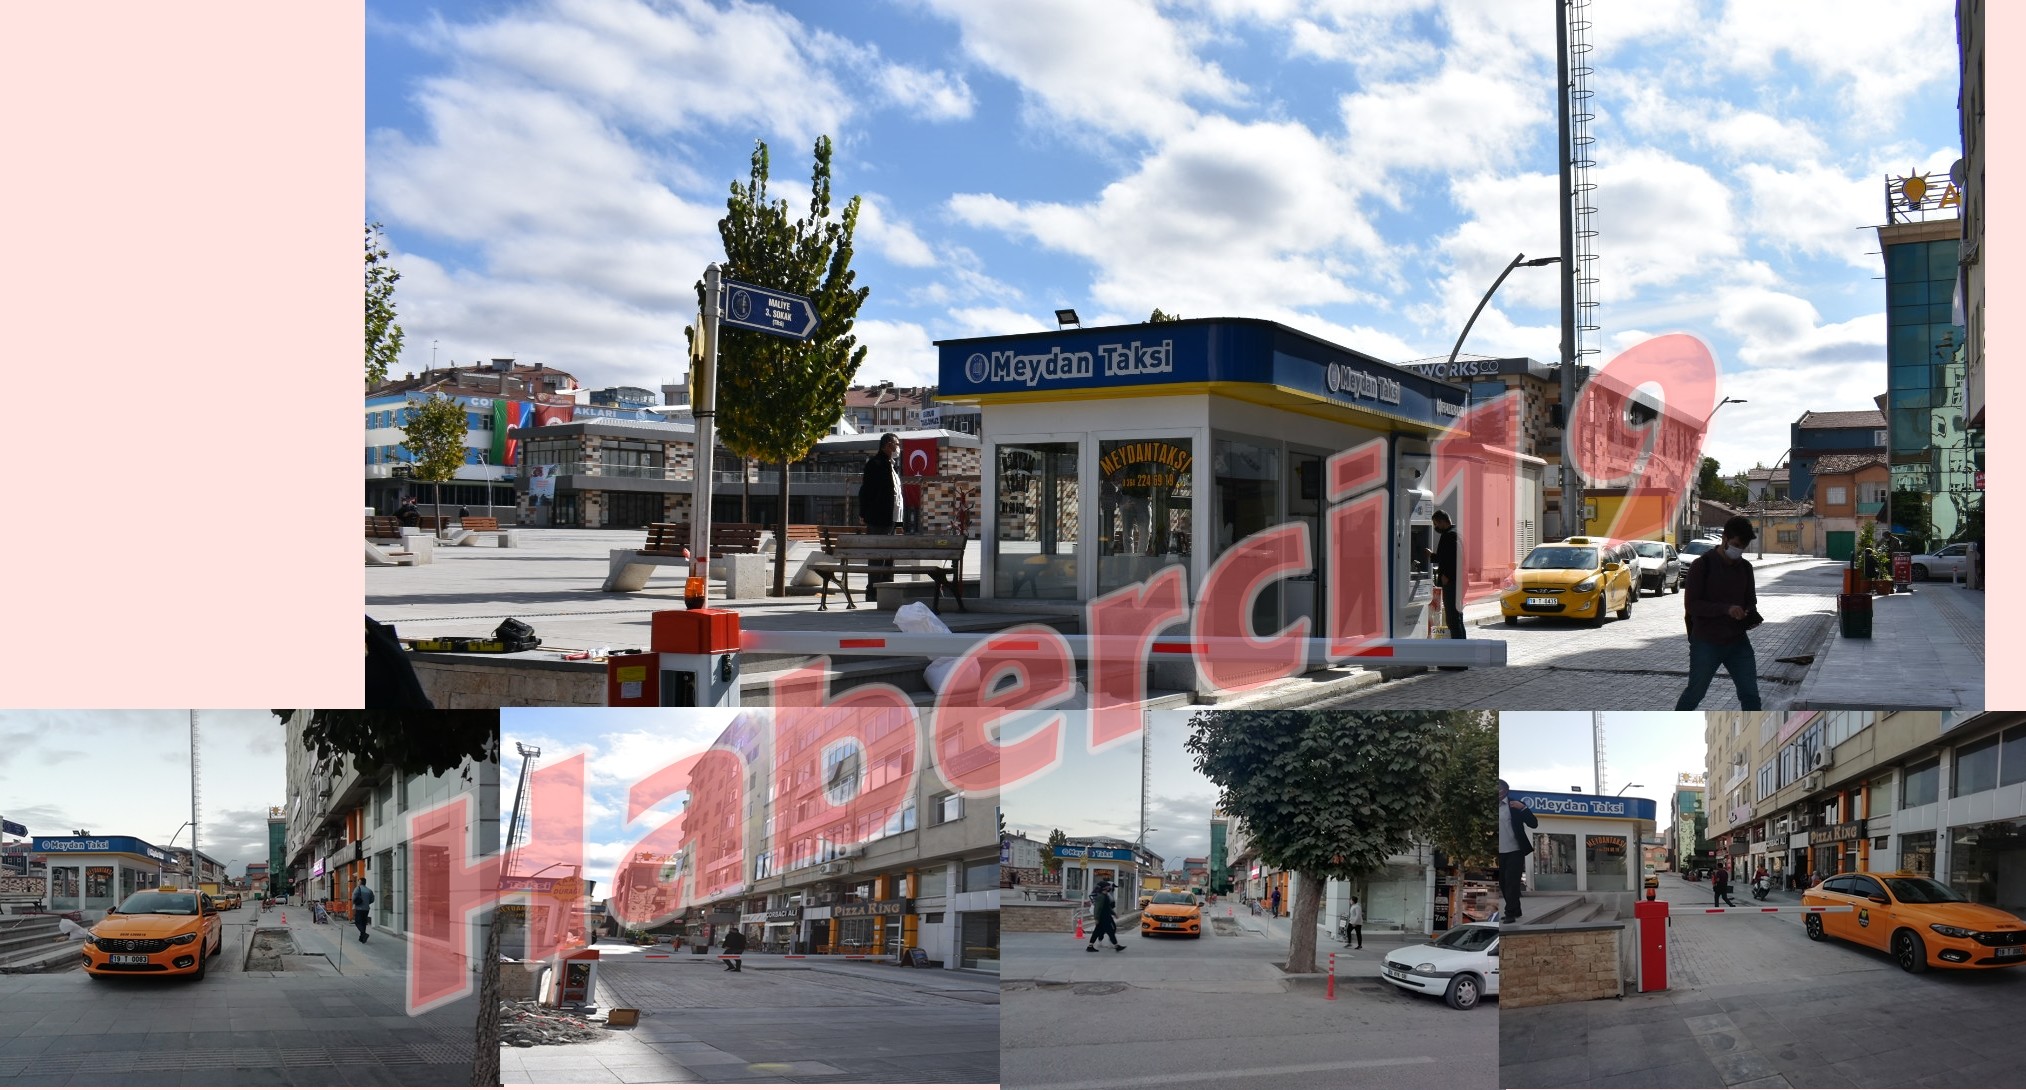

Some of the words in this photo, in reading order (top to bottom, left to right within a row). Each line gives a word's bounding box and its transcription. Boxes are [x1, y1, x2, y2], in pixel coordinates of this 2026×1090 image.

[768, 298, 791, 311] MALİYE
[765, 308, 771, 317] 3.
[772, 310, 792, 322] SOKAK
[991, 346, 1093, 387] Meydan
[1098, 339, 1173, 377] Taksi
[1480, 361, 1498, 373] CO
[1340, 365, 1378, 399] Meydan
[1378, 375, 1400, 405] Taksi
[573, 407, 617, 418] AKLARI
[1137, 474, 1151, 487] 224
[1153, 473, 1163, 486] 69
[1535, 797, 1588, 813] Meydan
[1590, 800, 1625, 815] Taksi
[51, 840, 85, 851] Meydan
[86, 839, 109, 850] Taksi
